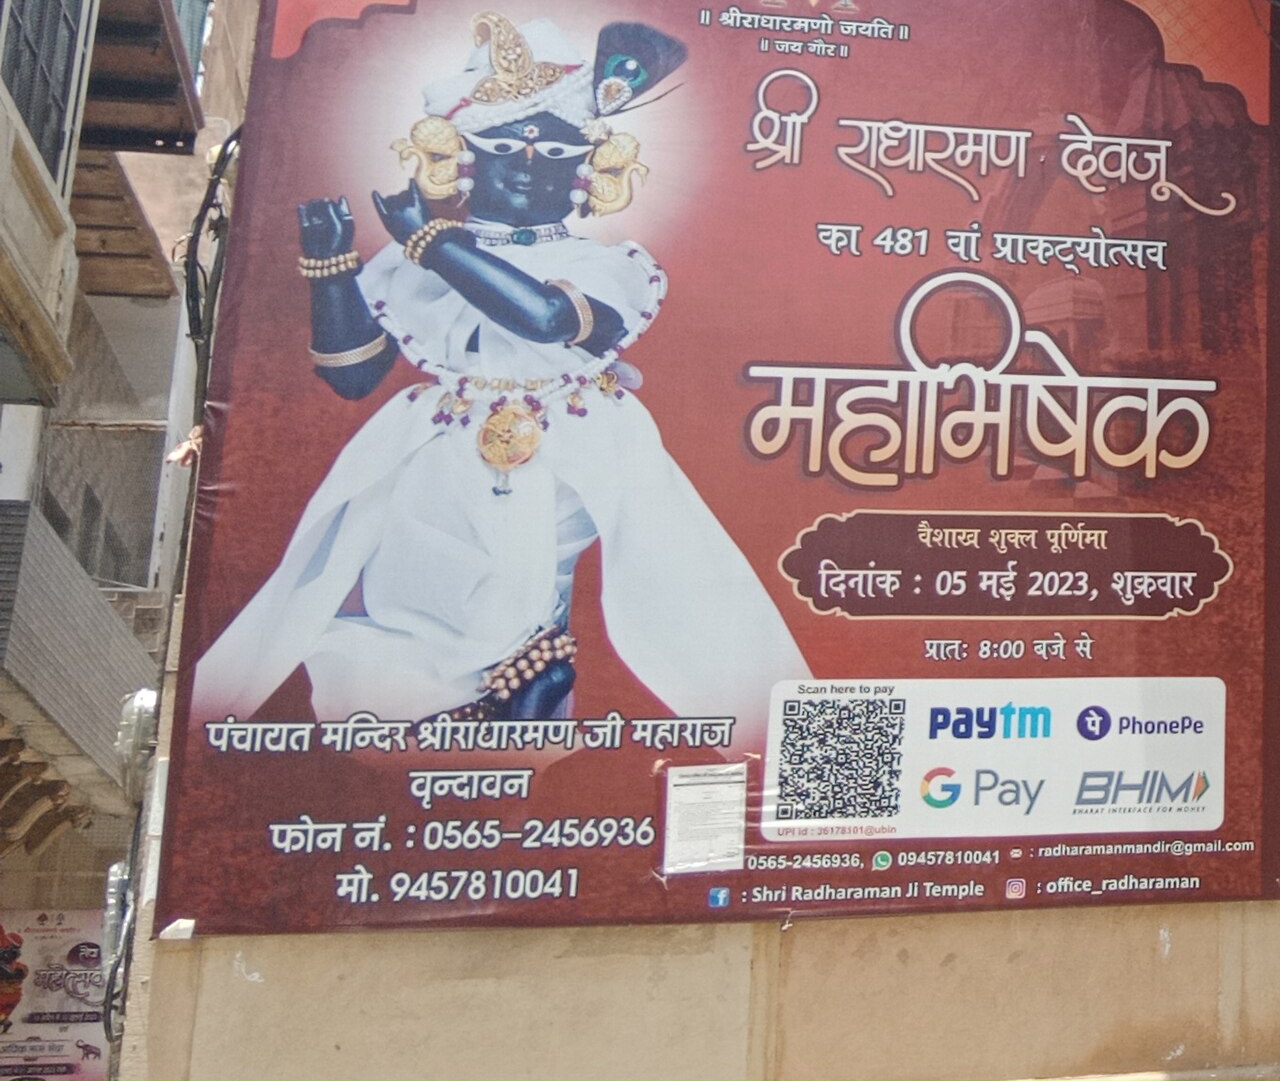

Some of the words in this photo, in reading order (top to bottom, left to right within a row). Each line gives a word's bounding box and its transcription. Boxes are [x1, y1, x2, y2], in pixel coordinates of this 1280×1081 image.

[719, 6, 833, 34] श्रीराधारमणो
[840, 18, 896, 39] जयति
[775, 40, 804, 54] जय
[807, 38, 837, 57] गौर
[745, 69, 820, 170] श्री
[838, 117, 1032, 202] राधारमण
[1059, 113, 1237, 217] देवजू
[817, 223, 861, 256] का
[873, 227, 929, 256] 481
[946, 221, 981, 262] वां
[993, 226, 1168, 274] प्राकट्योत्सव
[749, 272, 1217, 486] महाभिषेक
[917, 520, 980, 549] वैशाख
[988, 527, 1038, 552] शुक्ल
[1046, 522, 1108, 553] पूर्णिमा
[818, 559, 901, 598] दिनांक
[935, 571, 967, 596] 05
[978, 560, 1017, 602] मई
[1027, 571, 1099, 601] 2023,
[1110, 571, 1197, 605] शुक्रवार
[978, 639, 1024, 659] 8:00
[1033, 633, 1066, 660] बजे
[1074, 633, 1094, 660] से
[798, 684, 827, 694] Scan
[830, 684, 856, 694] here
[859, 685, 871, 693] to
[874, 685, 895, 696] pay
[205, 715, 315, 752] पंचायत
[320, 713, 412, 751] मन्दिर
[417, 713, 577, 750] श्रीराधारमण
[583, 711, 625, 748] जी
[631, 718, 736, 750] महाराज
[1118, 716, 1204, 735] PhonePe
[409, 770, 534, 809] वृन्दावन
[974, 769, 1045, 815] Pay
[1075, 770, 1196, 805] BHIM
[269, 815, 347, 853] फोन
[353, 814, 392, 851] नं.
[777, 827, 795, 836] UPI
[747, 853, 864, 870] 0565-2456936,
[898, 851, 1000, 867] 09457810041
[1038, 840, 1255, 857] radharamanmandir@gmail.com
[336, 864, 380, 903] मो.
[390, 868, 579, 901] 9457810041
[751, 886, 786, 902] Shri
[791, 884, 902, 901] Radharaman
[906, 882, 919, 898] Ji
[923, 880, 985, 899] Temple
[1046, 875, 1200, 895] office_radharaman
